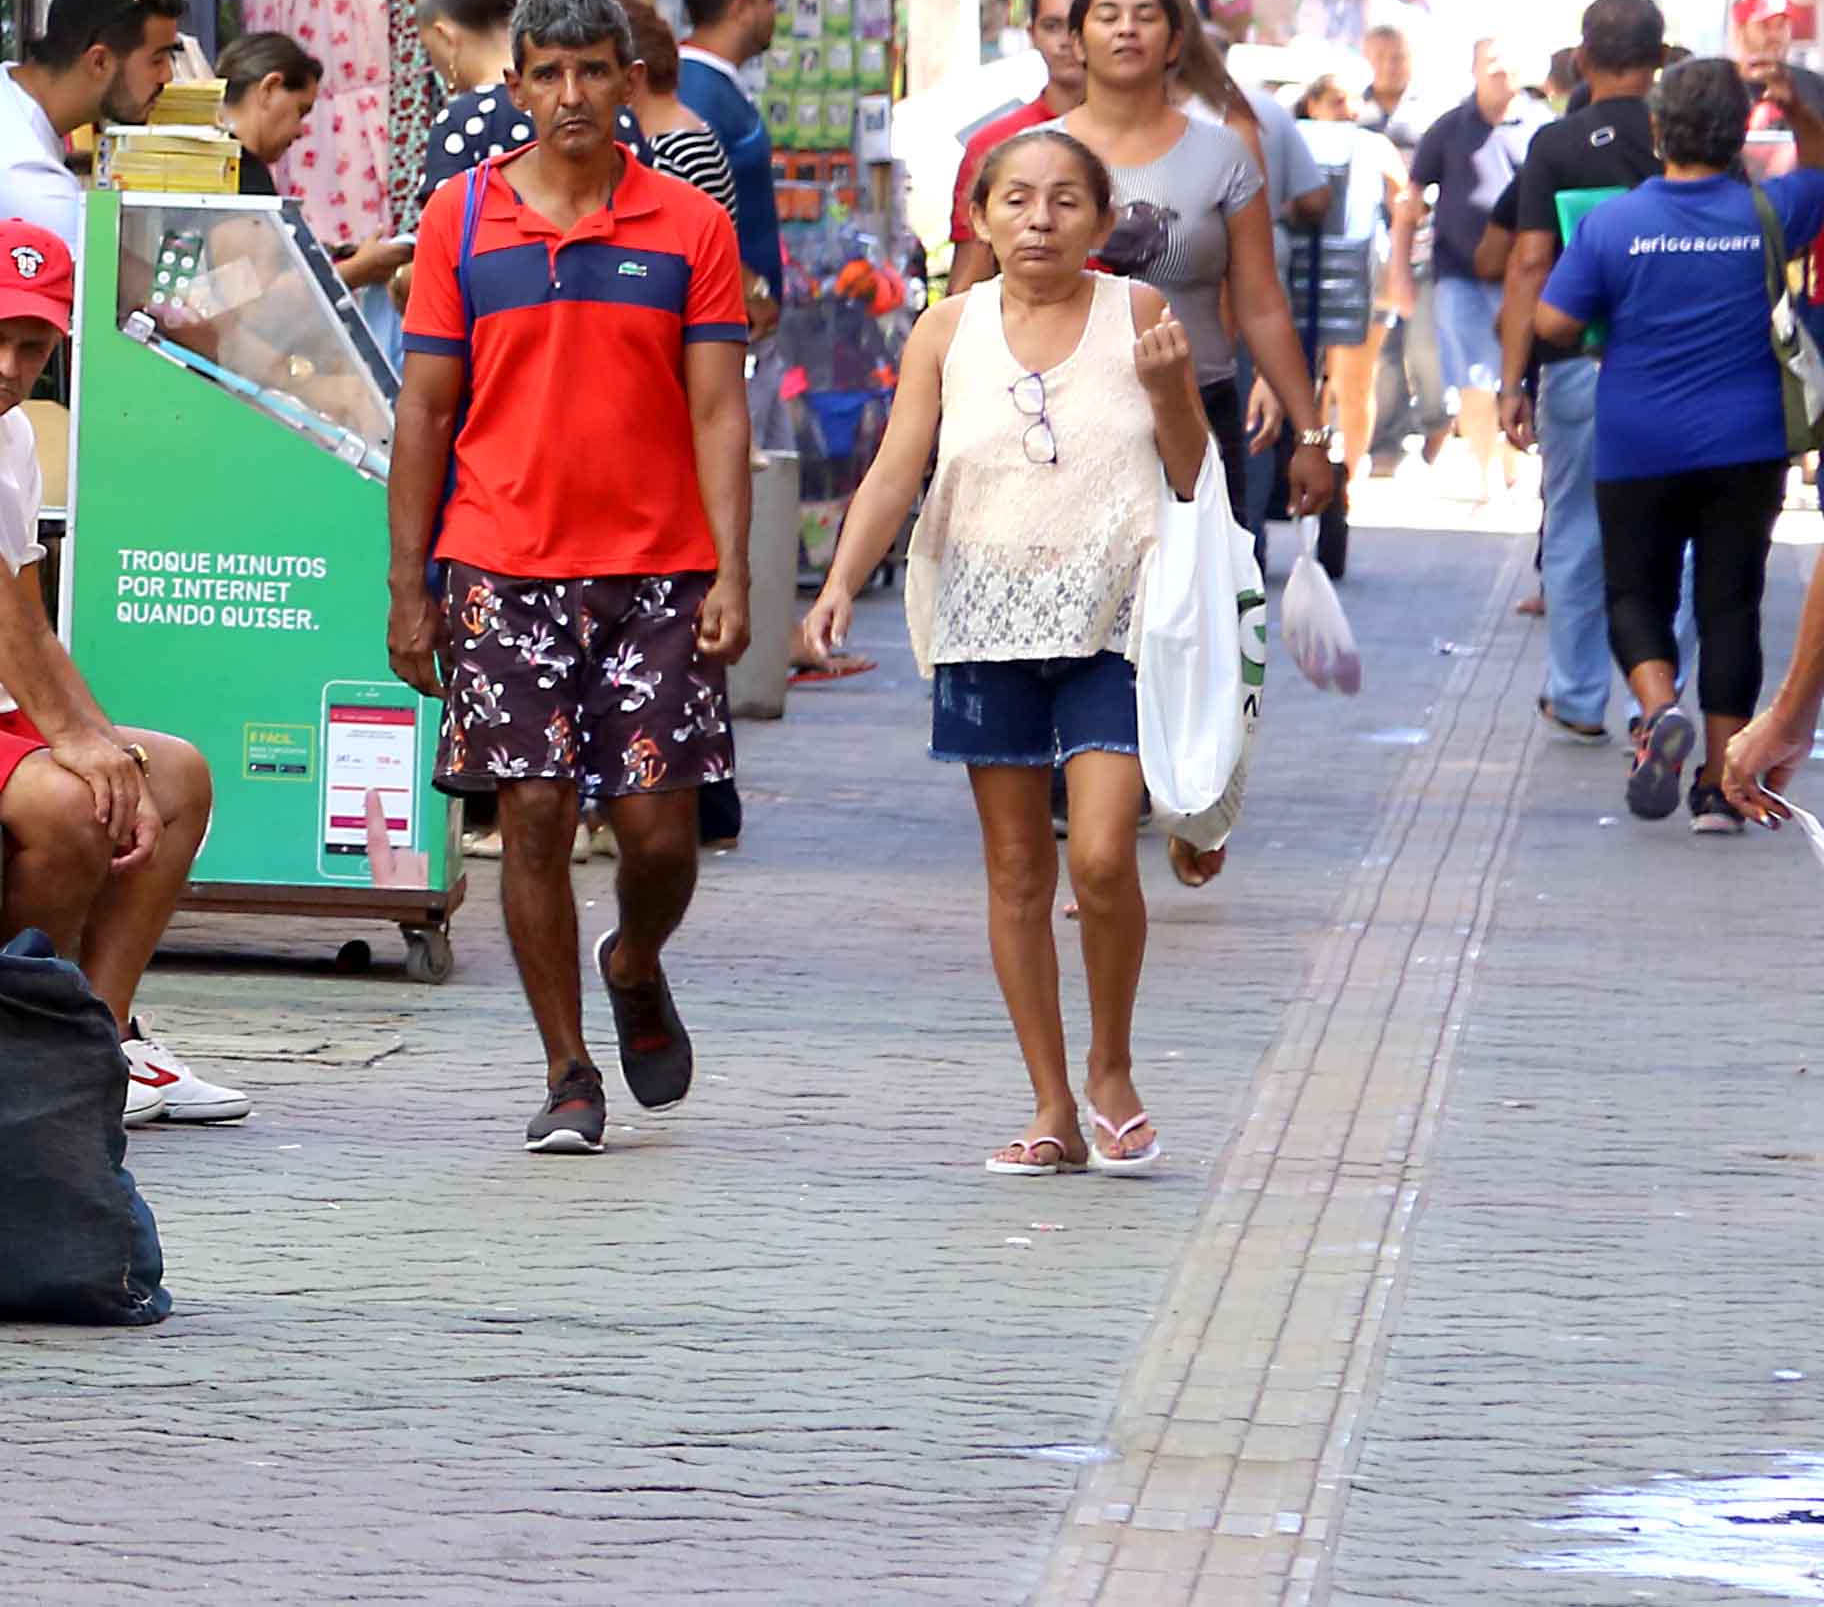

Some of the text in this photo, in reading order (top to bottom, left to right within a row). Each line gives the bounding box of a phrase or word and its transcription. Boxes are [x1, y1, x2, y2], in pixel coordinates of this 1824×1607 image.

[1629, 233, 1761, 256] Jericoacoara
[118, 549, 327, 578] TROQUE MINUTOS
[118, 575, 291, 603] POR INTERNET
[117, 603, 320, 631] QUANDO QUISER.
